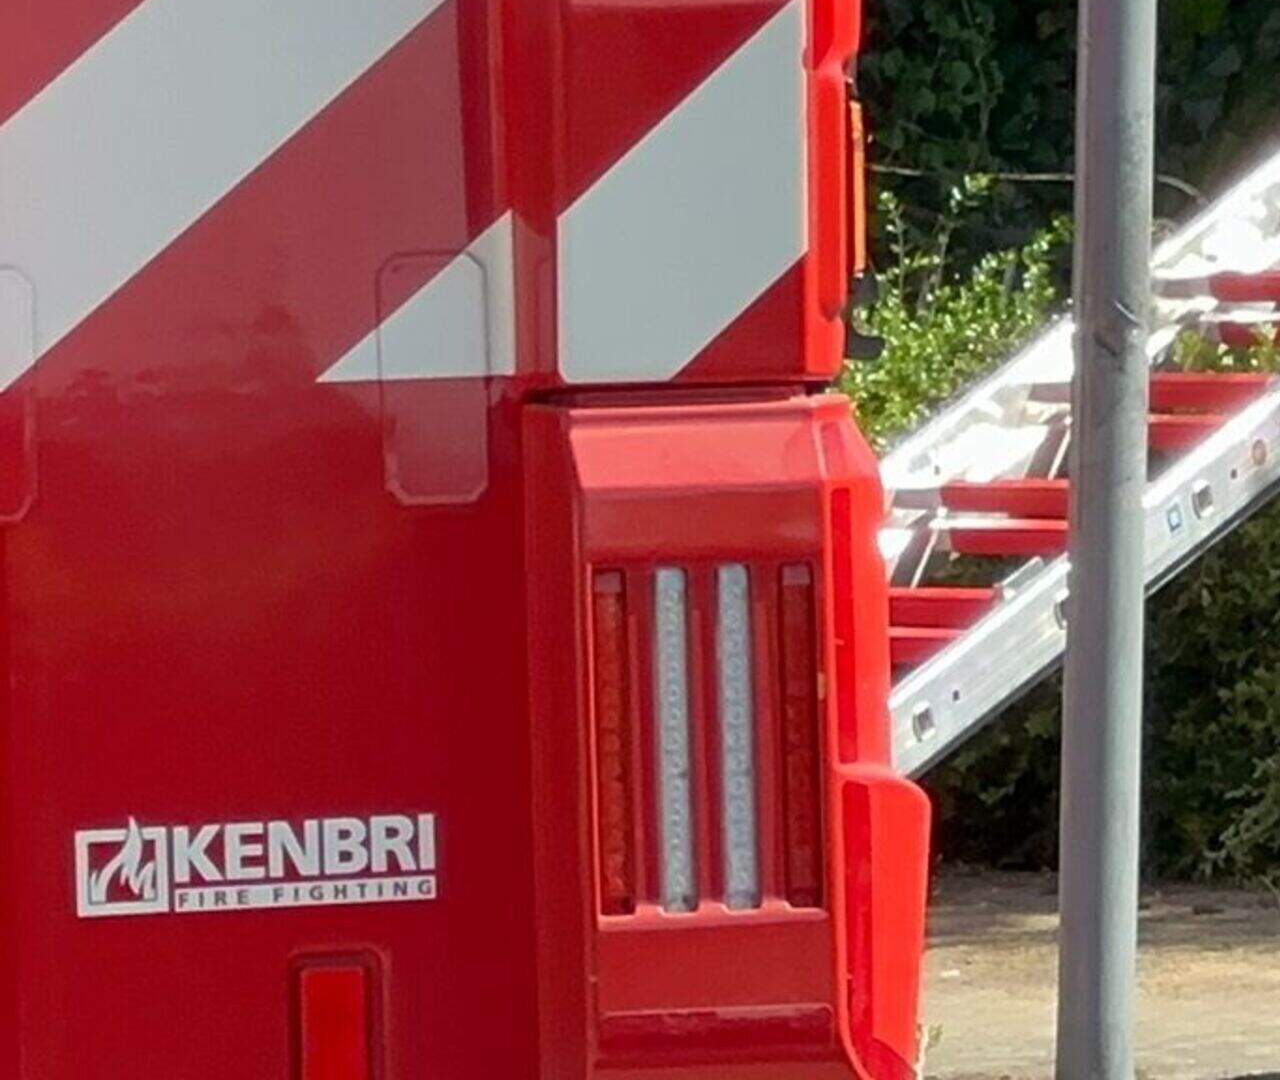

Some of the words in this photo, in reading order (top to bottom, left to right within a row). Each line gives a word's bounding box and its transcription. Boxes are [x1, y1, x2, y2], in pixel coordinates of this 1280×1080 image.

[172, 813, 436, 883] KENBRI
[179, 888, 251, 908] FIRE
[272, 878, 433, 903] FIGHTING
